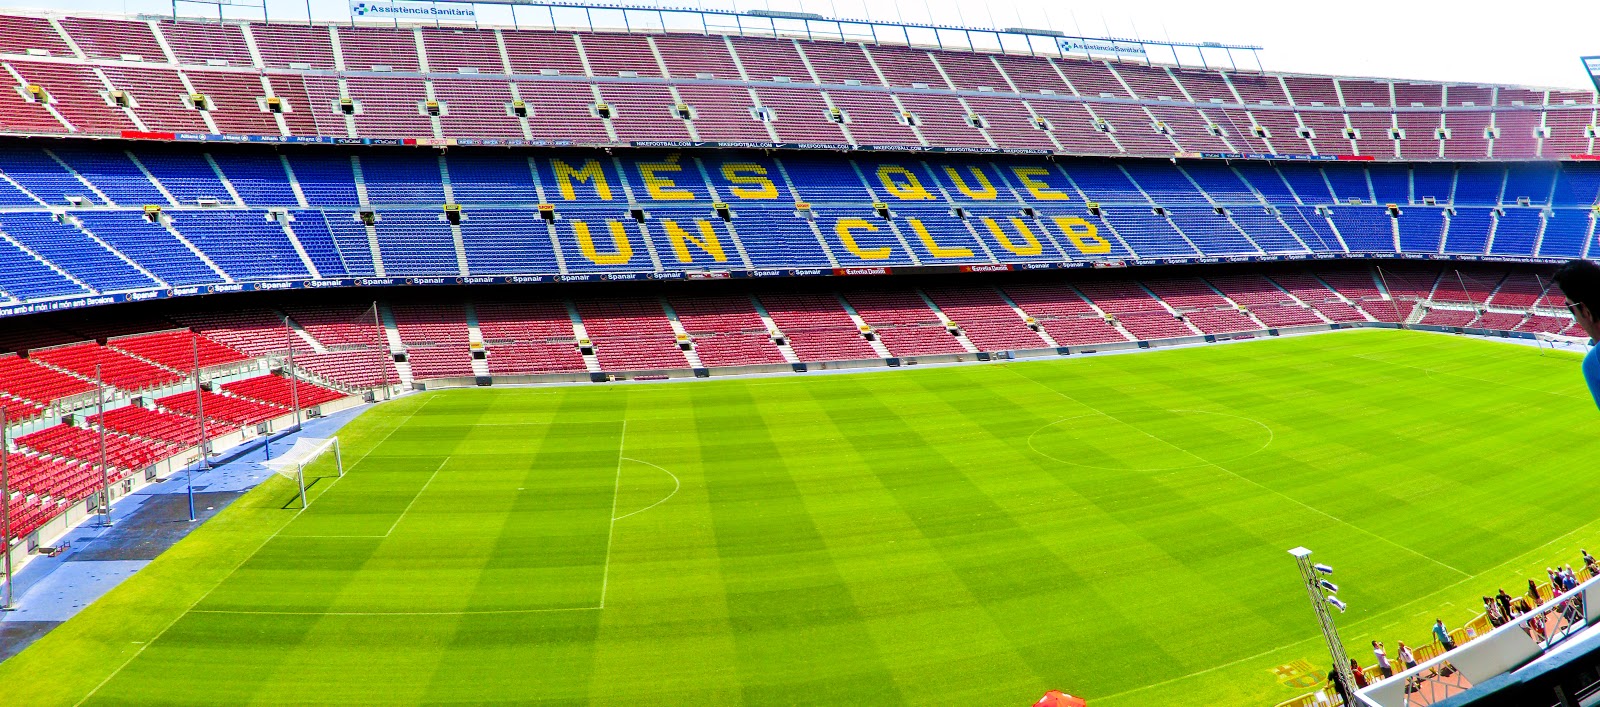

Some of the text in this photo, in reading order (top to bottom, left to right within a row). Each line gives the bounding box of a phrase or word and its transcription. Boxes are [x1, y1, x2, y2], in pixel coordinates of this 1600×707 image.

[370, 5, 475, 16] Assistència Sanitària
[551, 153, 1069, 201] MÉS QUE
[570, 216, 1112, 265] UN CLUB
[261, 281, 292, 290] Spanair
[311, 279, 342, 288] Spanair
[362, 277, 393, 285] Spanair
[174, 287, 199, 296] Spanair
[213, 283, 243, 292] Spanair
[132, 290, 158, 300] Spanair
[87, 296, 115, 305] Barcelona
